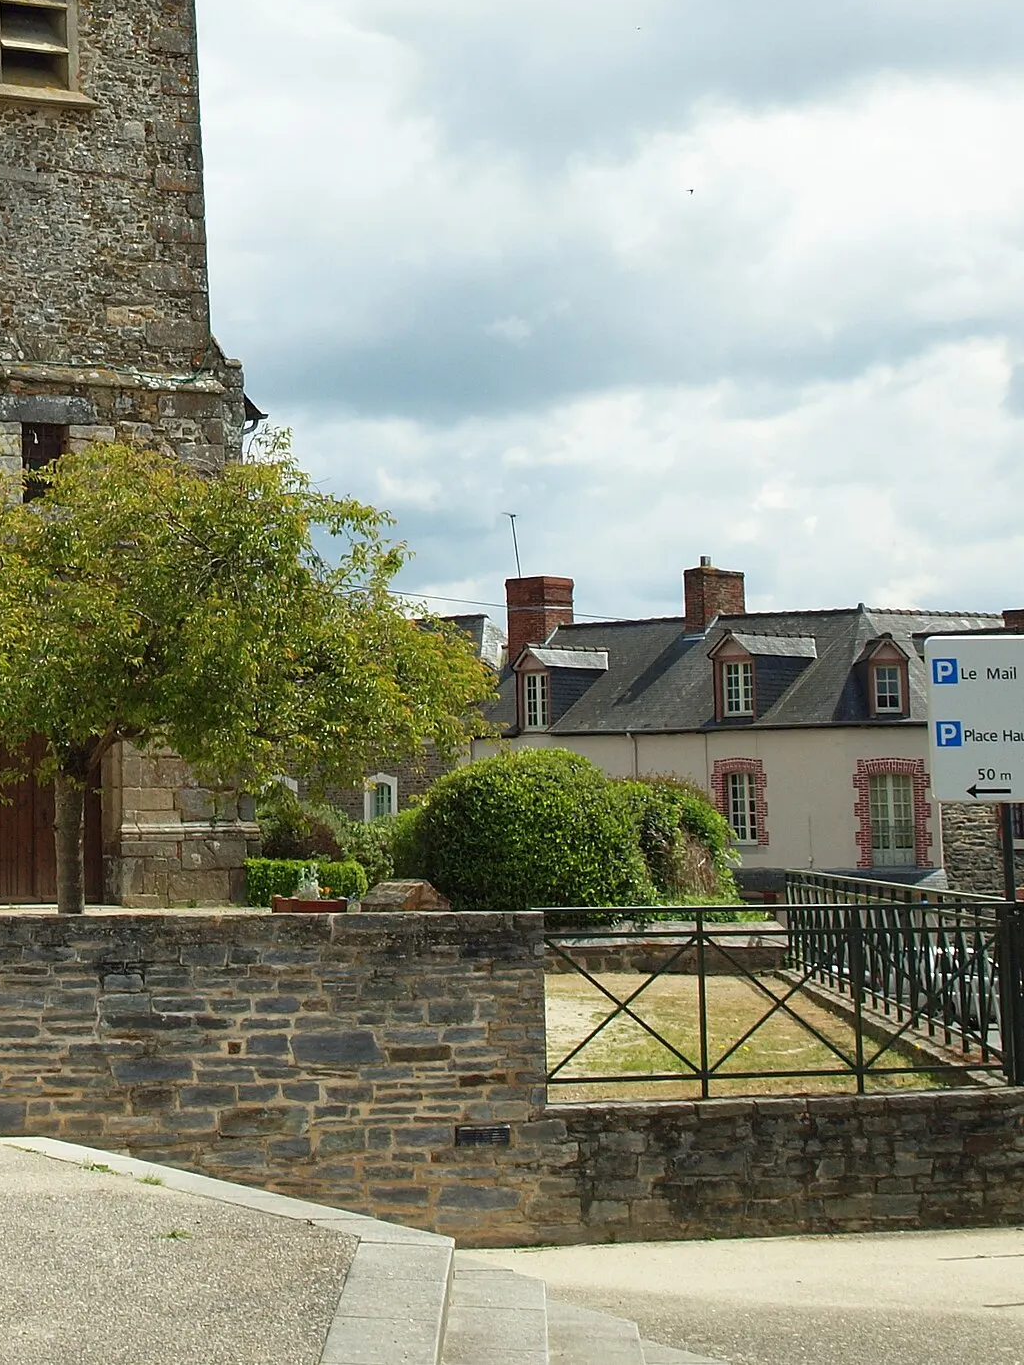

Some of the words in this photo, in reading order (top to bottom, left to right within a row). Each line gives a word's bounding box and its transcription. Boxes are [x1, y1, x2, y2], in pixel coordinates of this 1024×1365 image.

[937, 661, 953, 682] P
[961, 668, 977, 680] Le
[987, 667, 1017, 680] Mail
[940, 723, 957, 745] P
[964, 729, 998, 742] Place
[978, 768, 996, 781] 50
[1000, 772, 1012, 781] m
